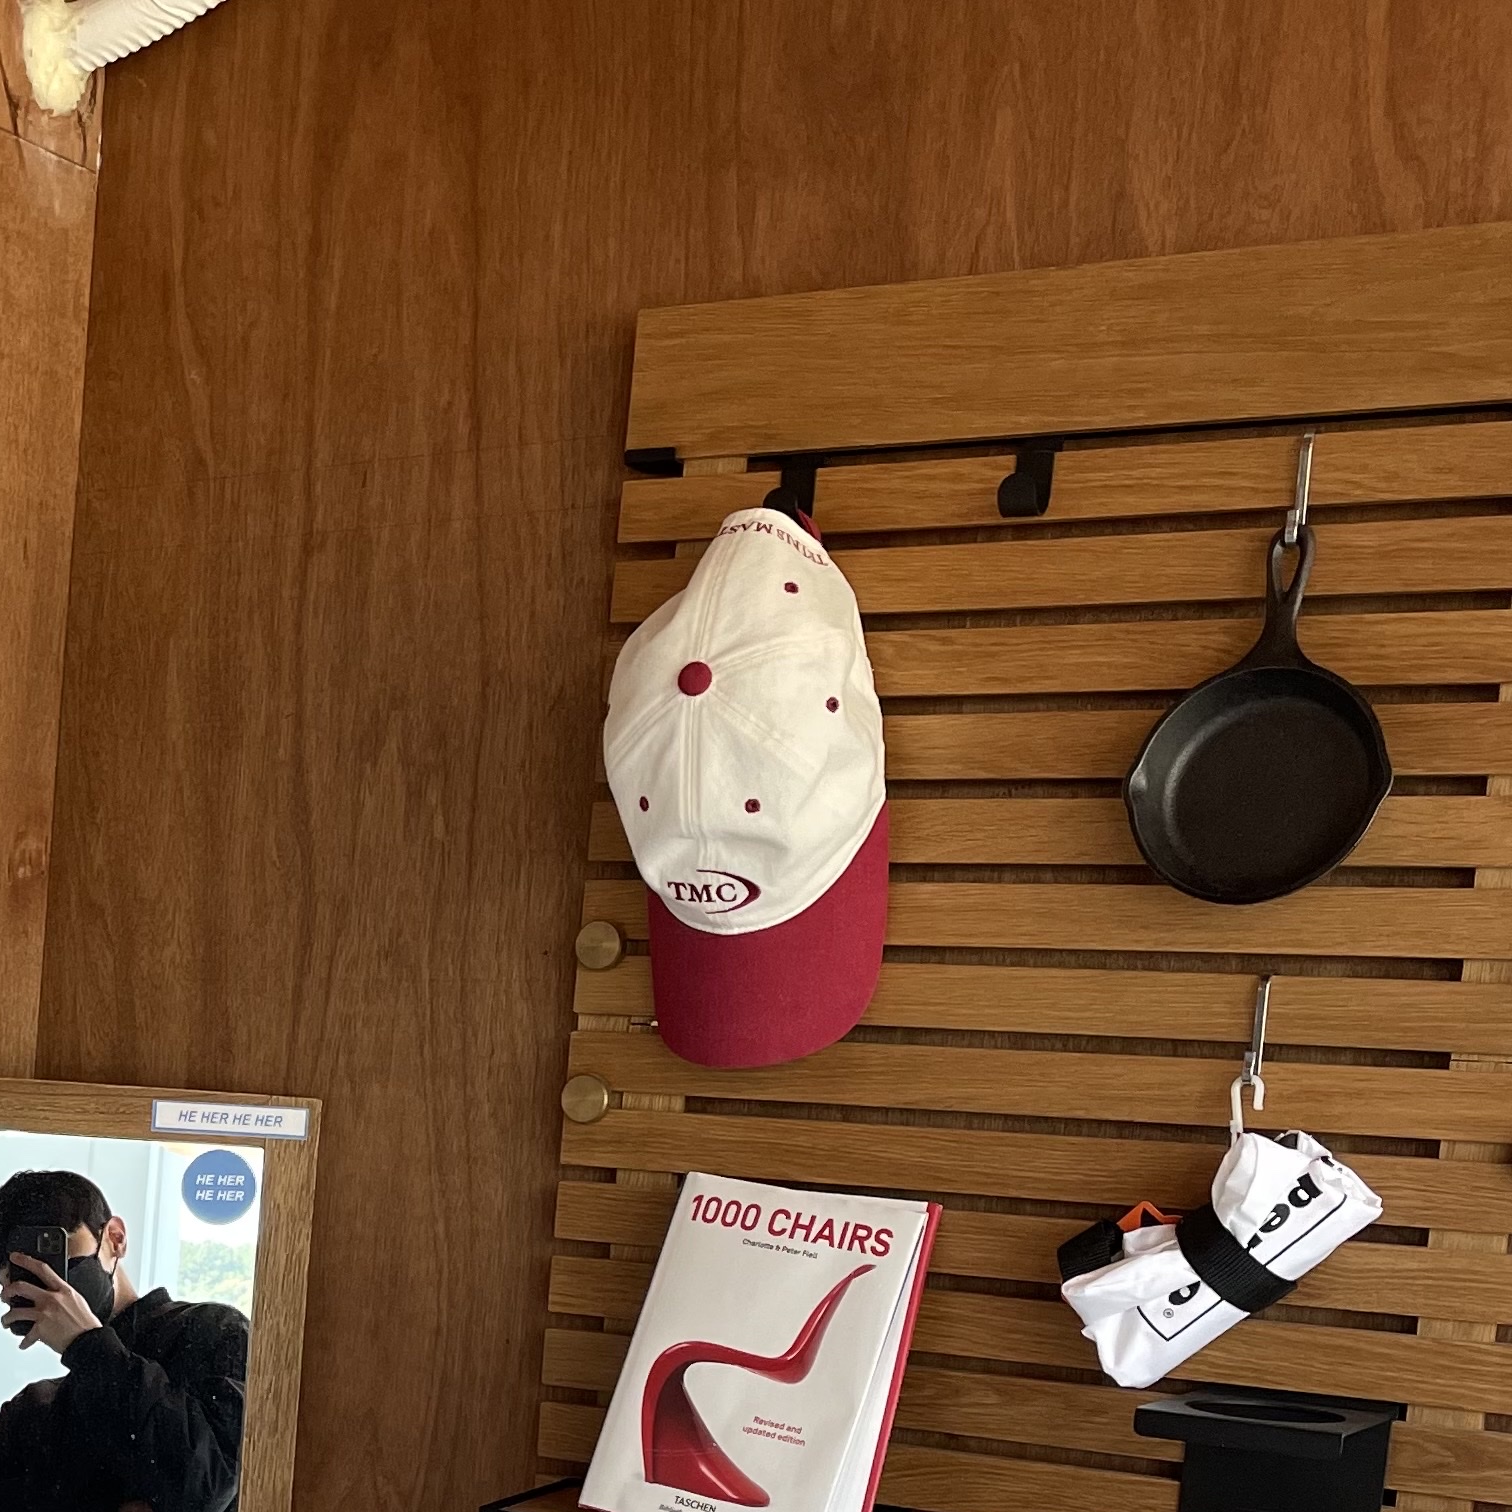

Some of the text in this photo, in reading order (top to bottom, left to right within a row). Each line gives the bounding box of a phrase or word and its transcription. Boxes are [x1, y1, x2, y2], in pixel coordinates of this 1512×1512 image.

[667, 881, 738, 903] TMC
[178, 1110, 283, 1128] HE HER HE HER
[195, 1174, 245, 1186] HE HER
[195, 1189, 245, 1202] HE HER
[691, 1194, 894, 1257] 1000 CHAIRS
[752, 1416, 803, 1434] Revised and
[742, 1426, 806, 1447] updated edition
